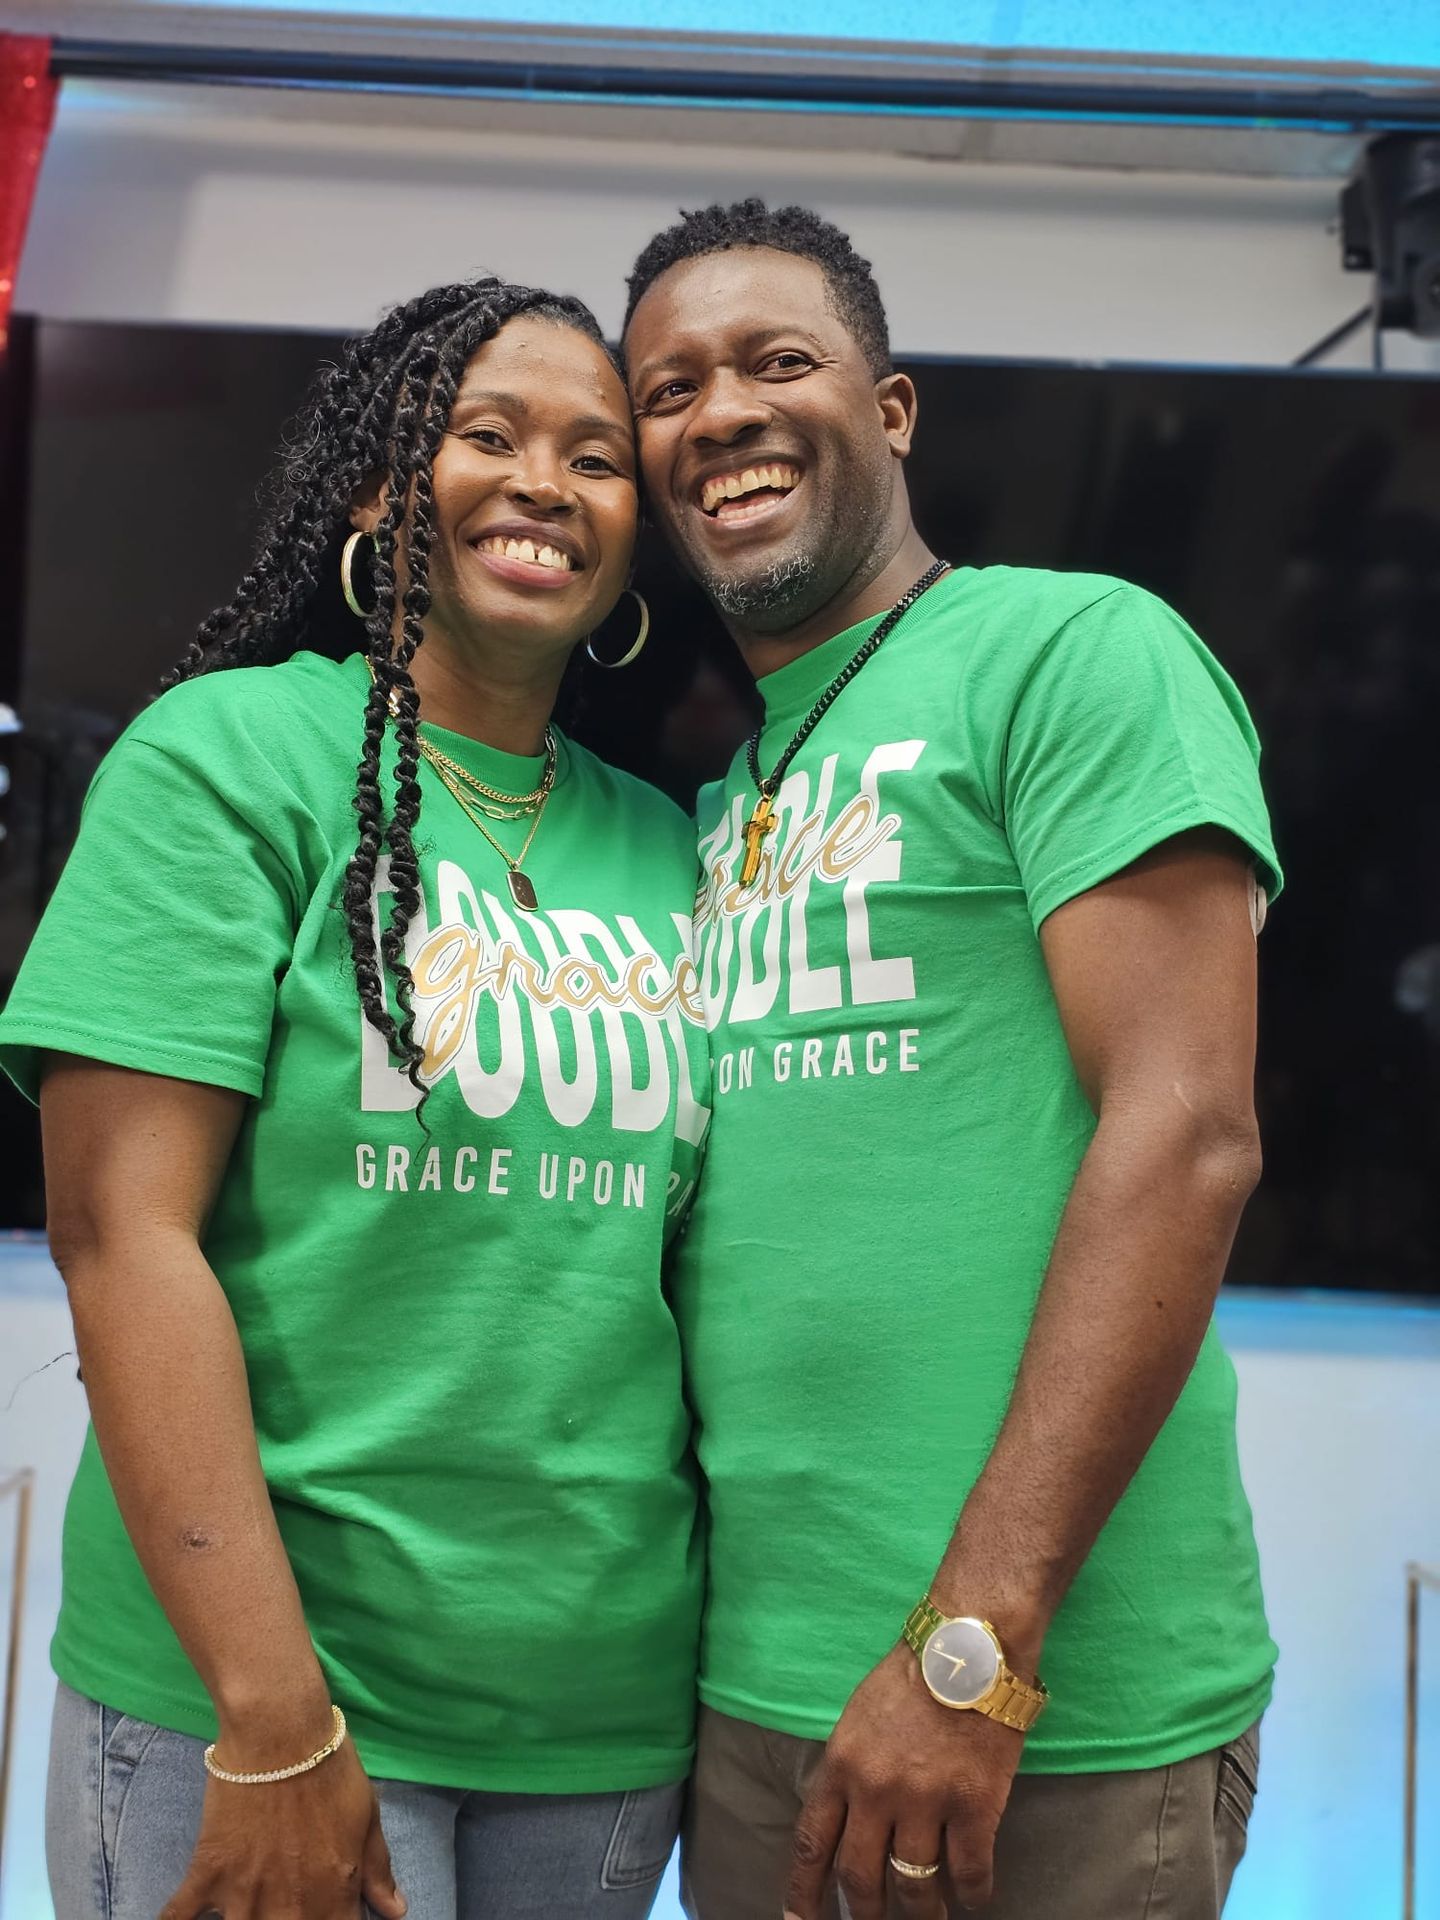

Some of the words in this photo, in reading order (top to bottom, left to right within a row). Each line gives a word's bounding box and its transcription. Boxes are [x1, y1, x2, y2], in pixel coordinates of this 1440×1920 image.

[410, 922, 707, 1081] grace
[709, 1046, 755, 1095] ON
[774, 1028, 920, 1083] GRACE
[355, 1143, 513, 1196] GRACE
[538, 1152, 646, 1208] UPON
